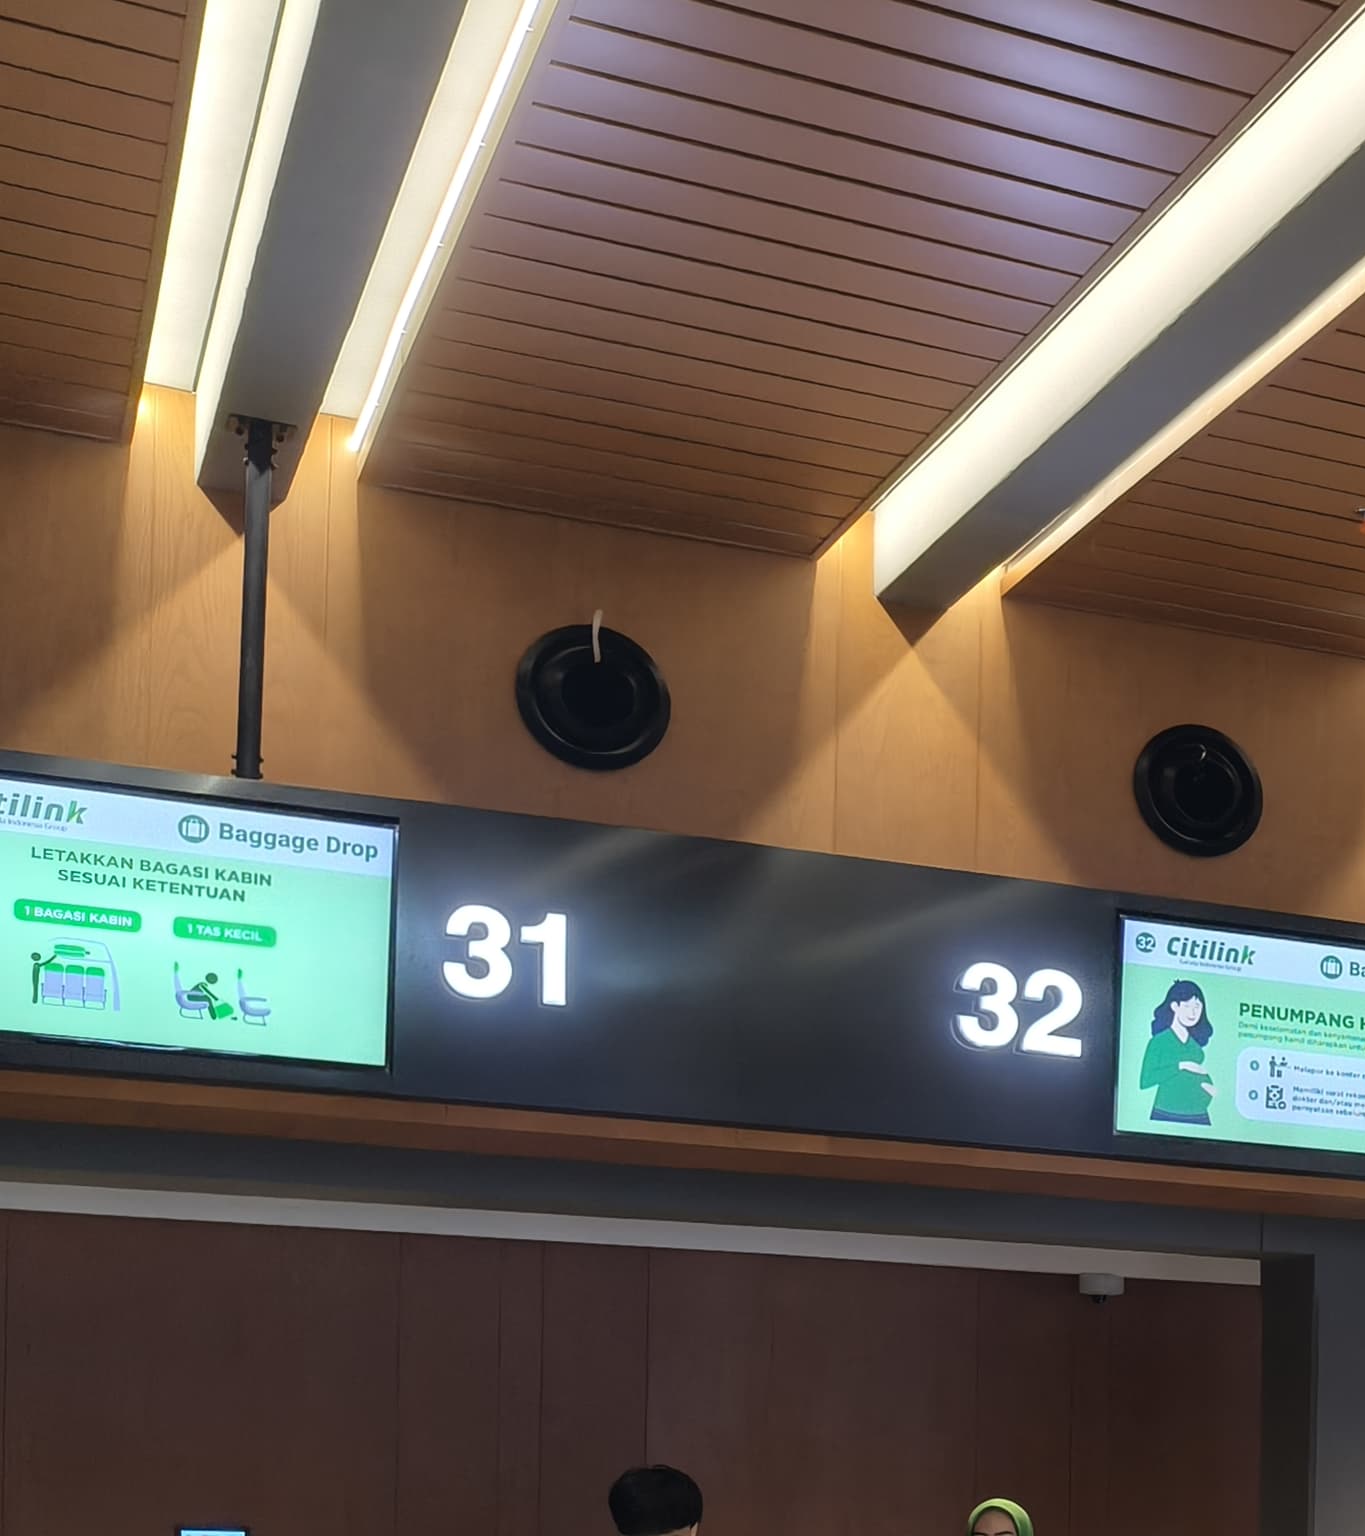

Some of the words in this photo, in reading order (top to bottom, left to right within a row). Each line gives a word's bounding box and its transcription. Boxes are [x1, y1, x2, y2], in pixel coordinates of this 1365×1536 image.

[0, 793, 88, 825] tilink
[219, 826, 319, 853] Baggage
[326, 835, 378, 862] Drop
[31, 846, 133, 869] LETAKKAN
[140, 860, 209, 880] BAGASI
[215, 868, 272, 886] KABIN
[58, 869, 126, 889] SESUAI
[132, 879, 246, 902] KETENTUAN
[33, 907, 86, 923] BAGASI
[89, 912, 133, 927] KABIN
[195, 925, 221, 938] TAS
[224, 927, 263, 942] KECIL
[1137, 936, 1155, 948] 32
[443, 904, 568, 1007] 31
[1167, 936, 1256, 965] Citilink
[955, 961, 1083, 1057] 32
[1239, 1003, 1354, 1029] PENUMPANG
